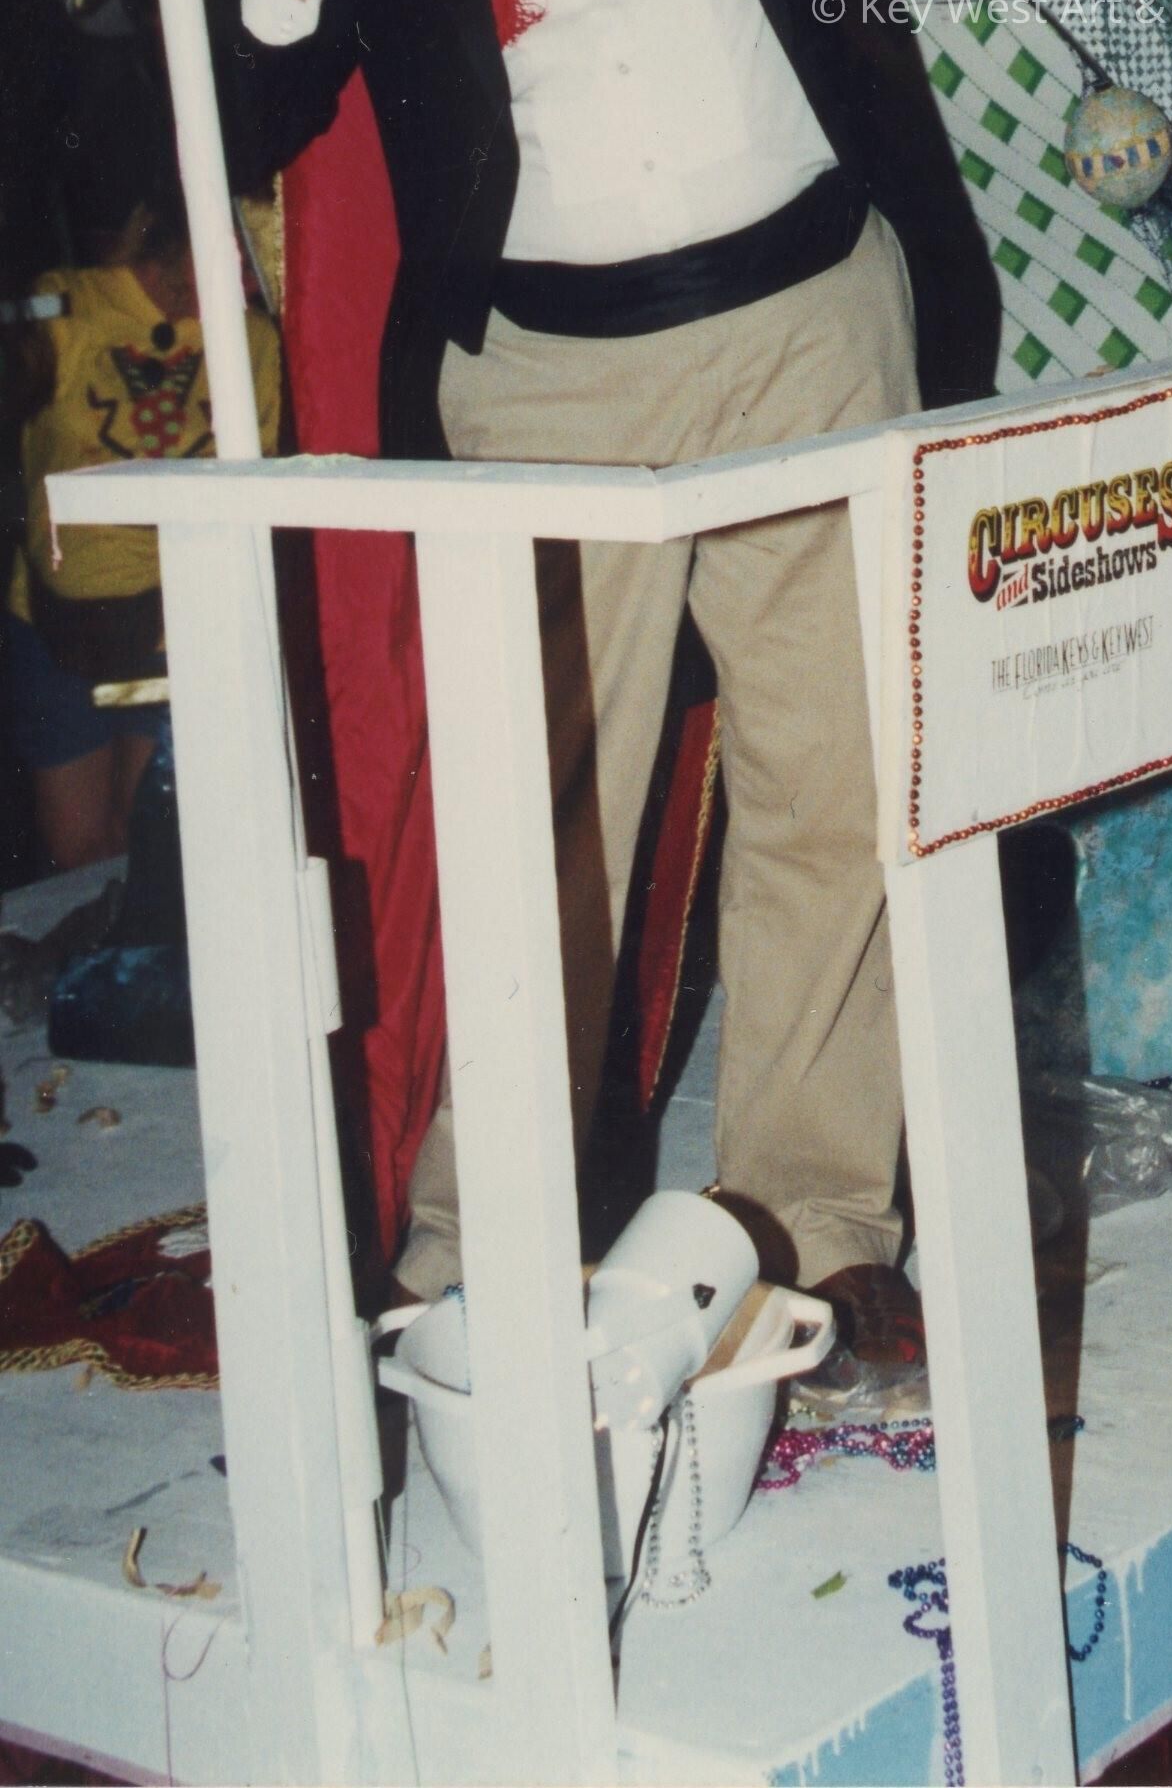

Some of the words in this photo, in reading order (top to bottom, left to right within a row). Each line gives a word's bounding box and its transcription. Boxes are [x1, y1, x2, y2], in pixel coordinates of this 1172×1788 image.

[996, 563, 1029, 611] and
[1031, 541, 1157, 603] Sideshows
[992, 657, 1011, 691] THE
[1015, 645, 1059, 689] FLORIDA
[1062, 633, 1089, 675] KEYS
[1091, 630, 1100, 660] &
[1101, 626, 1121, 663] KEY
[1124, 615, 1154, 655] WEST
